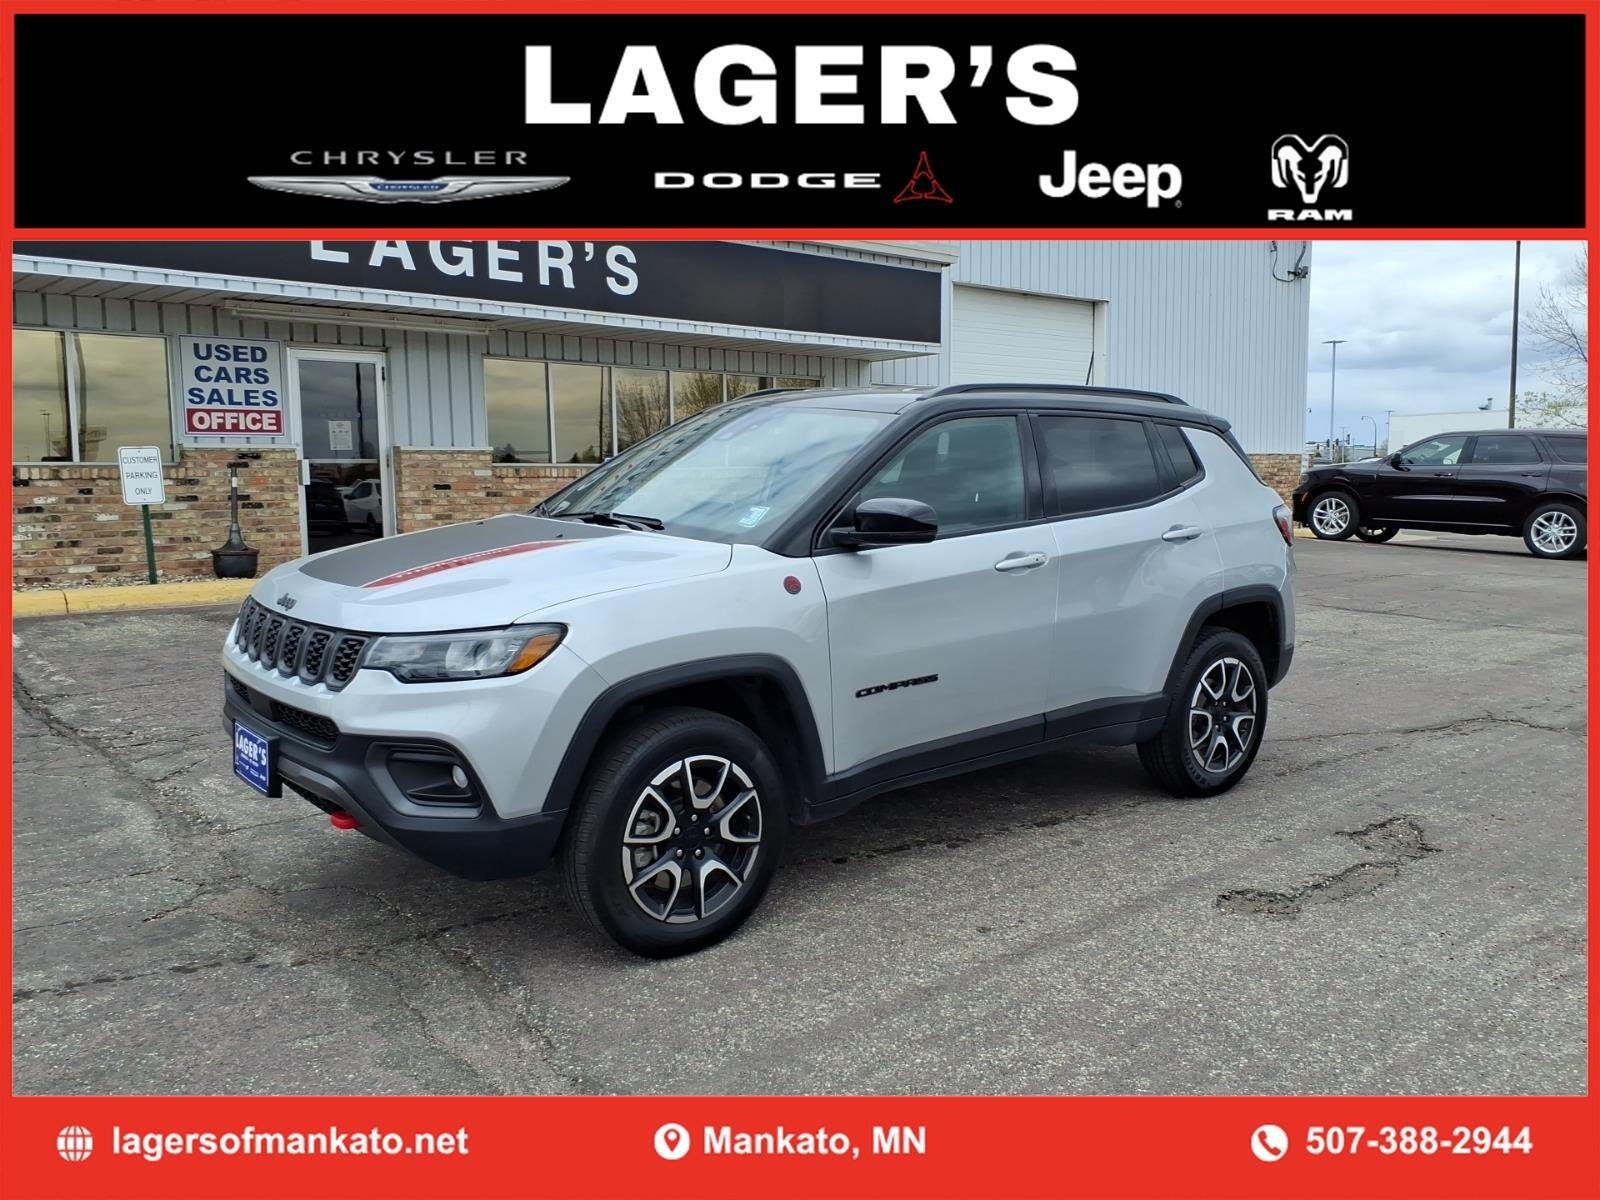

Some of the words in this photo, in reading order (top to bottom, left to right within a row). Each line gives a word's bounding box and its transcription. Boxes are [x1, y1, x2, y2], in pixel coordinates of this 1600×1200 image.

[193, 343, 267, 363] USED
[194, 365, 270, 385] CARS
[188, 387, 278, 407] SALES
[192, 411, 278, 431] OFFICE
[122, 456, 158, 464] CUSTOMER
[126, 471, 158, 479] PARKING
[135, 487, 152, 495] ONLY
[235, 731, 267, 767] LAGER'S
